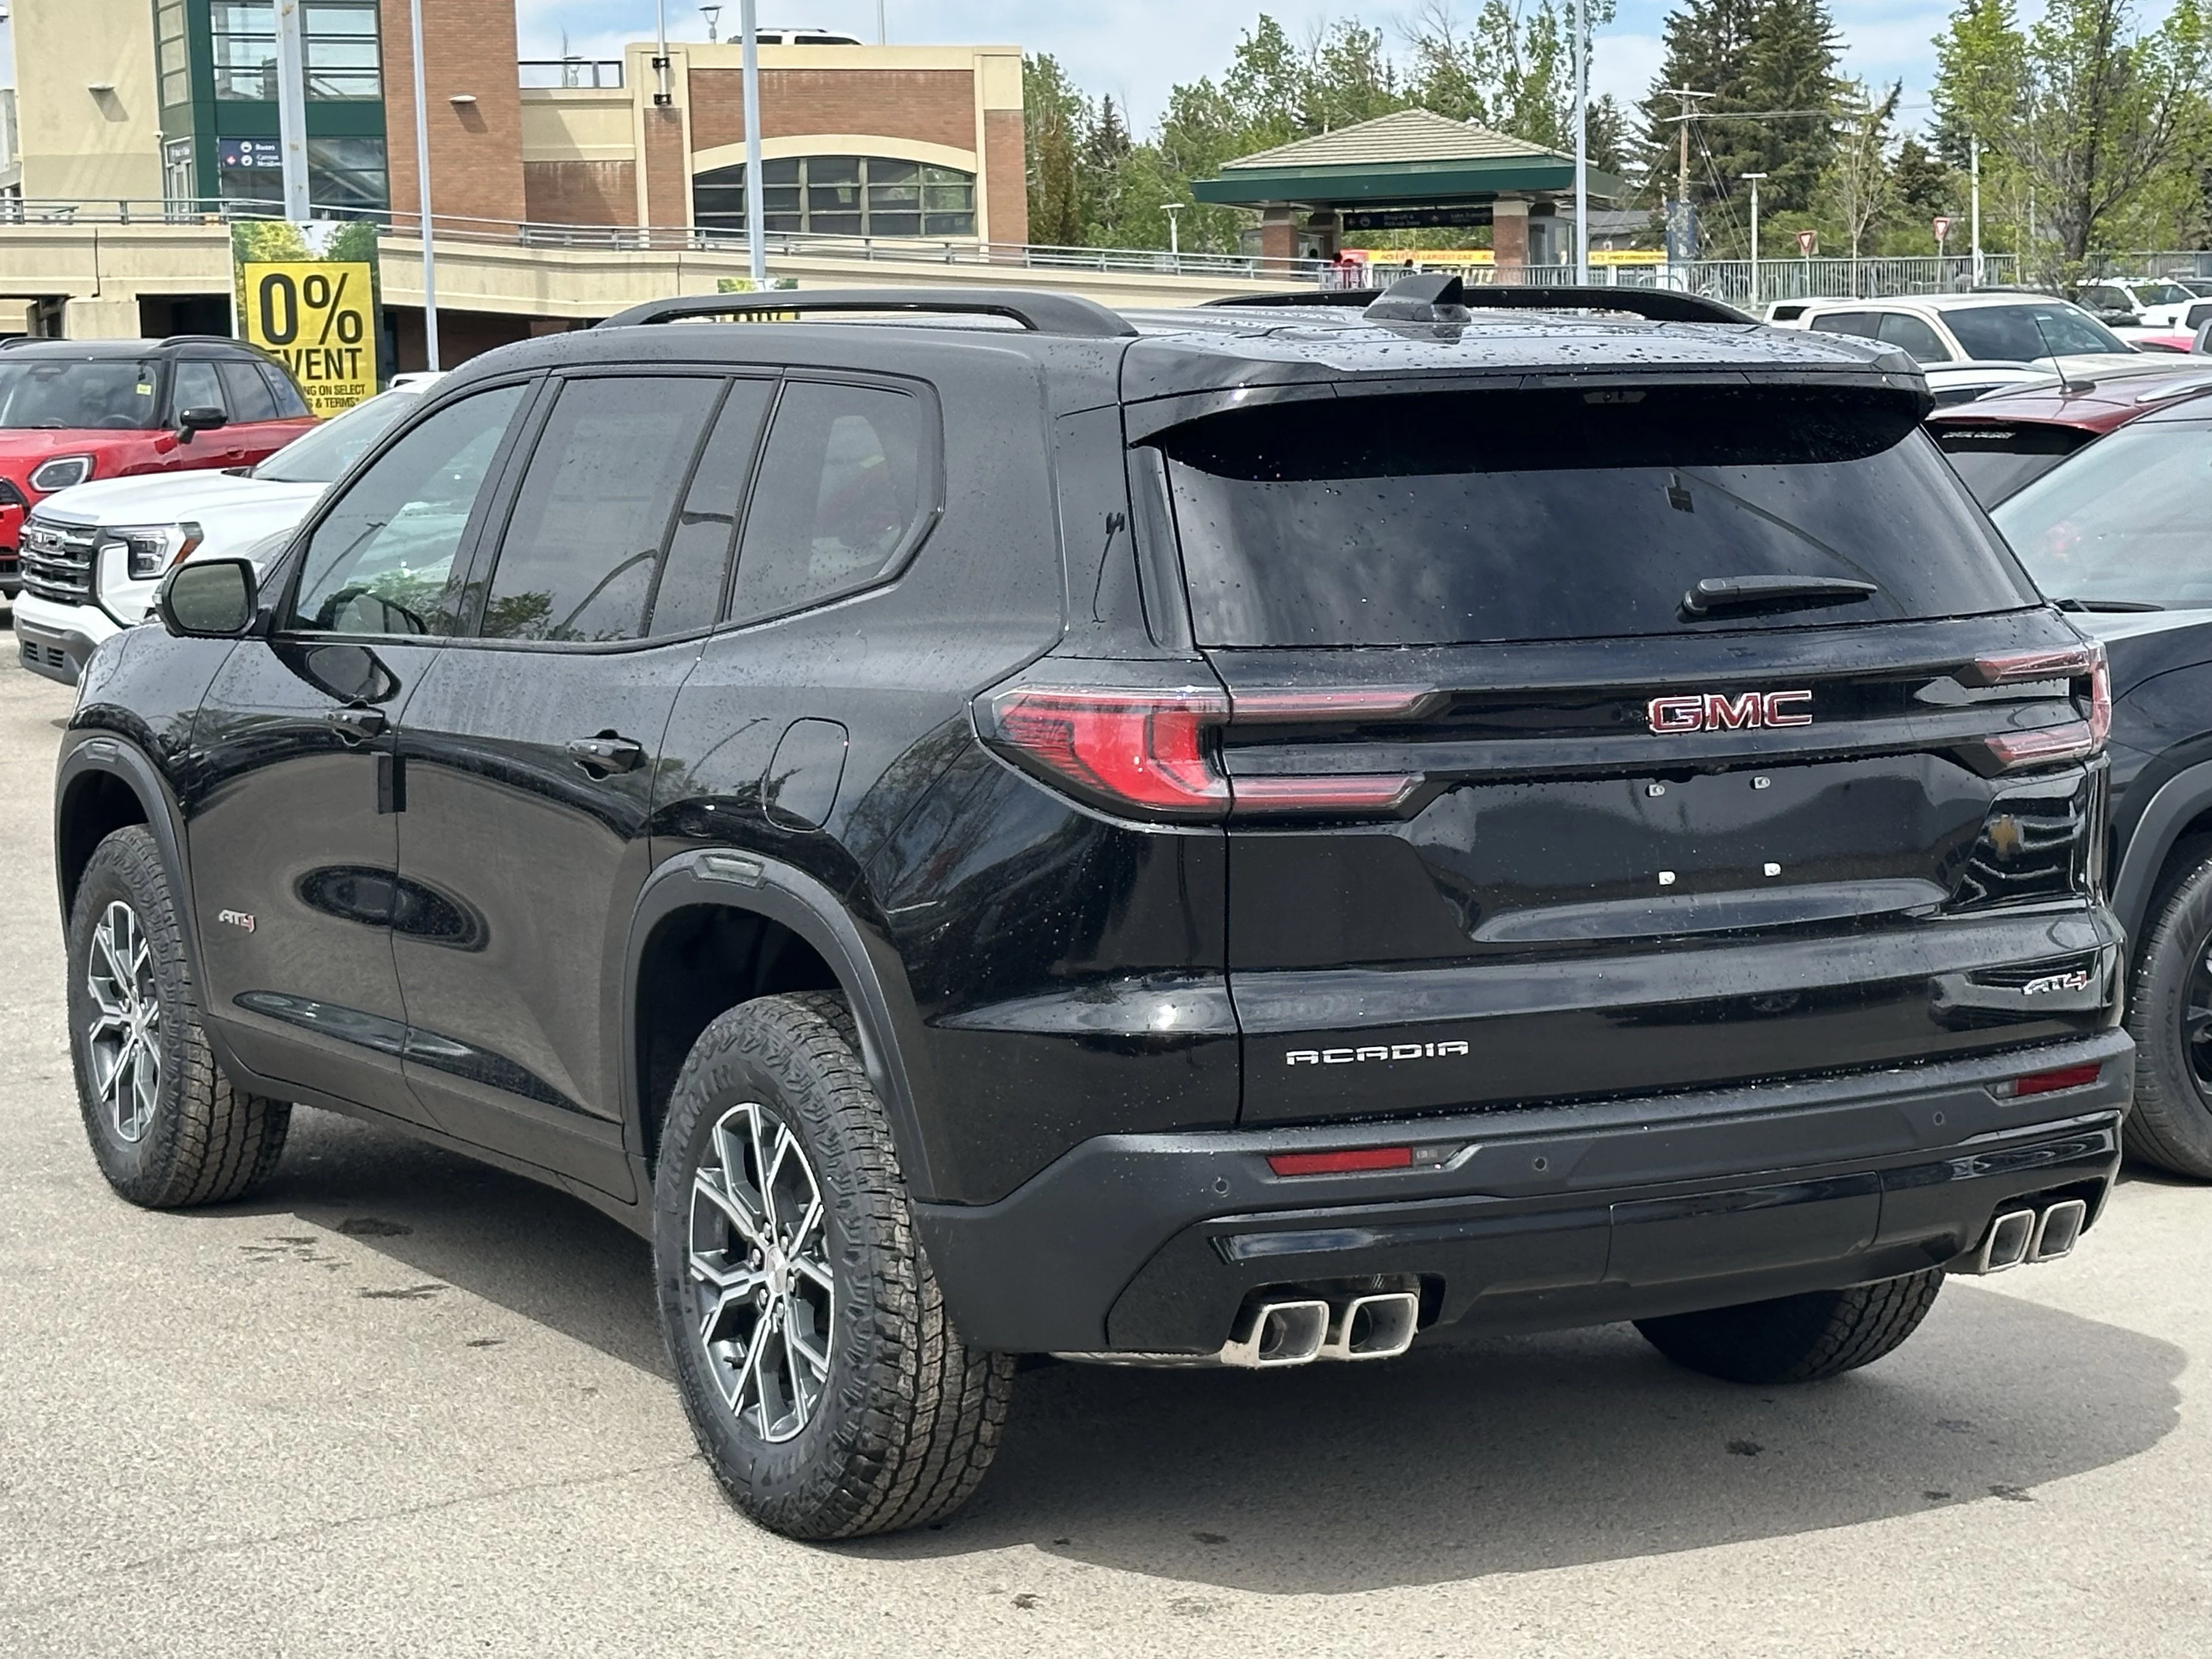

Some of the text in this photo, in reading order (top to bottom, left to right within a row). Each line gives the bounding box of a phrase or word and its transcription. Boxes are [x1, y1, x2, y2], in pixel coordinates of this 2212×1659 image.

[259, 273, 363, 346] 0%
[266, 348, 363, 380] VENT
[319, 385, 332, 396] ON
[334, 384, 365, 395] SELECT
[315, 398, 323, 408] &
[1648, 690, 1812, 733] GMC
[218, 909, 255, 933] AT4
[2023, 970, 2087, 995] AT4
[1285, 1041, 1469, 1066] ACADIA
